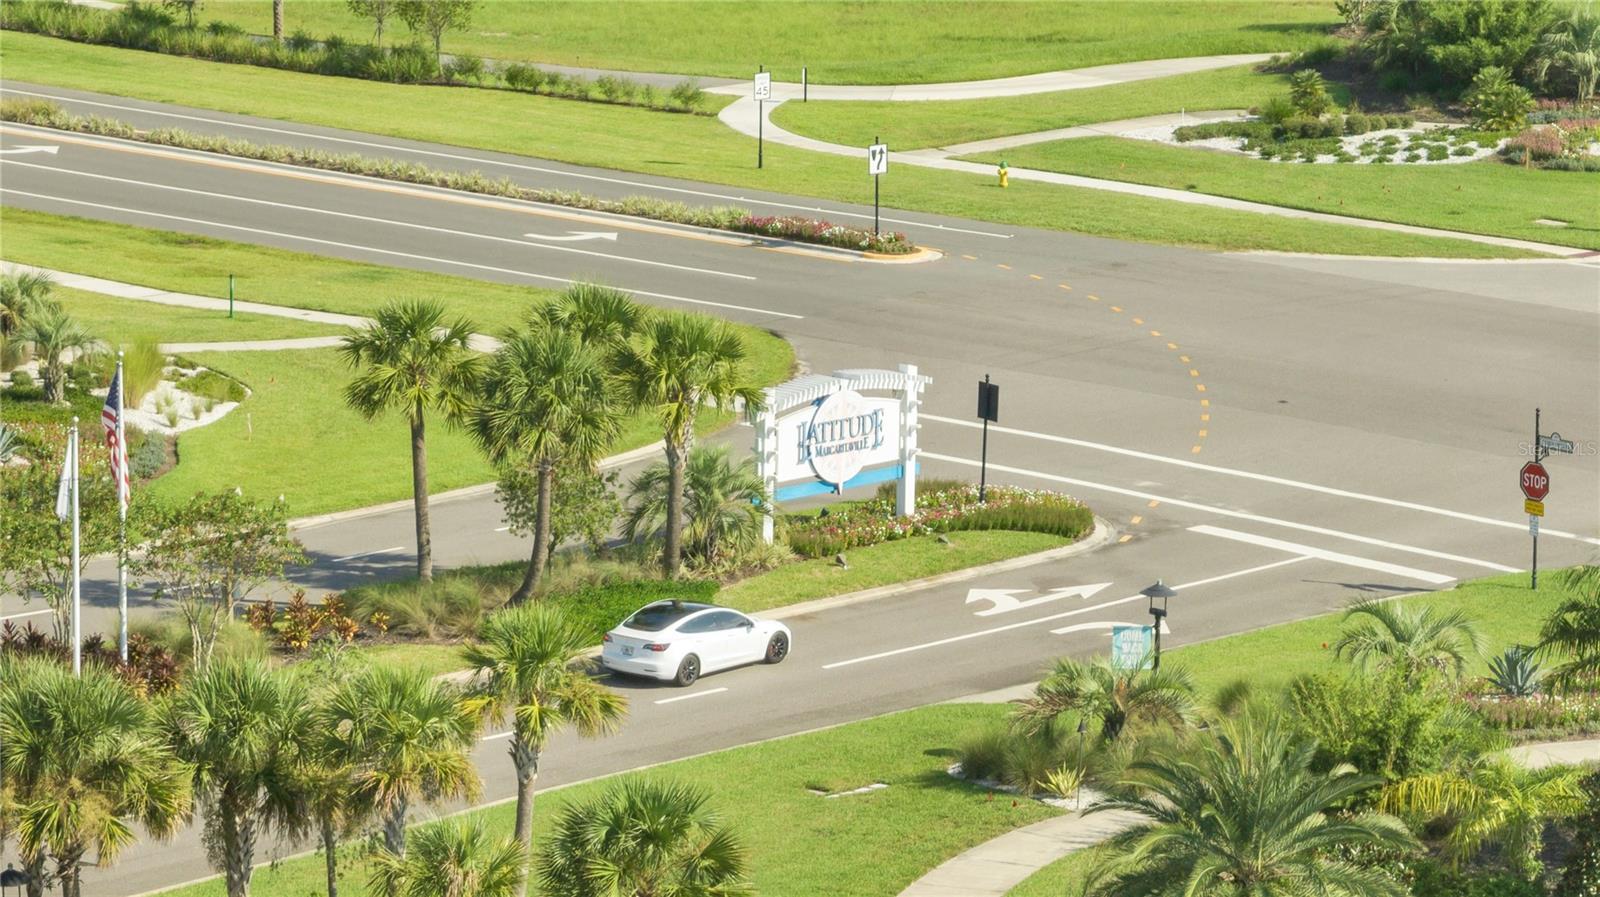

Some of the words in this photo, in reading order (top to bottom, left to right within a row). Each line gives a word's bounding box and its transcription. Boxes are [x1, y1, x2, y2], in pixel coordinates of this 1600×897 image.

[756, 86, 769, 96] 45
[796, 408, 884, 465] LATITUDE
[1523, 473, 1547, 489] STOP
